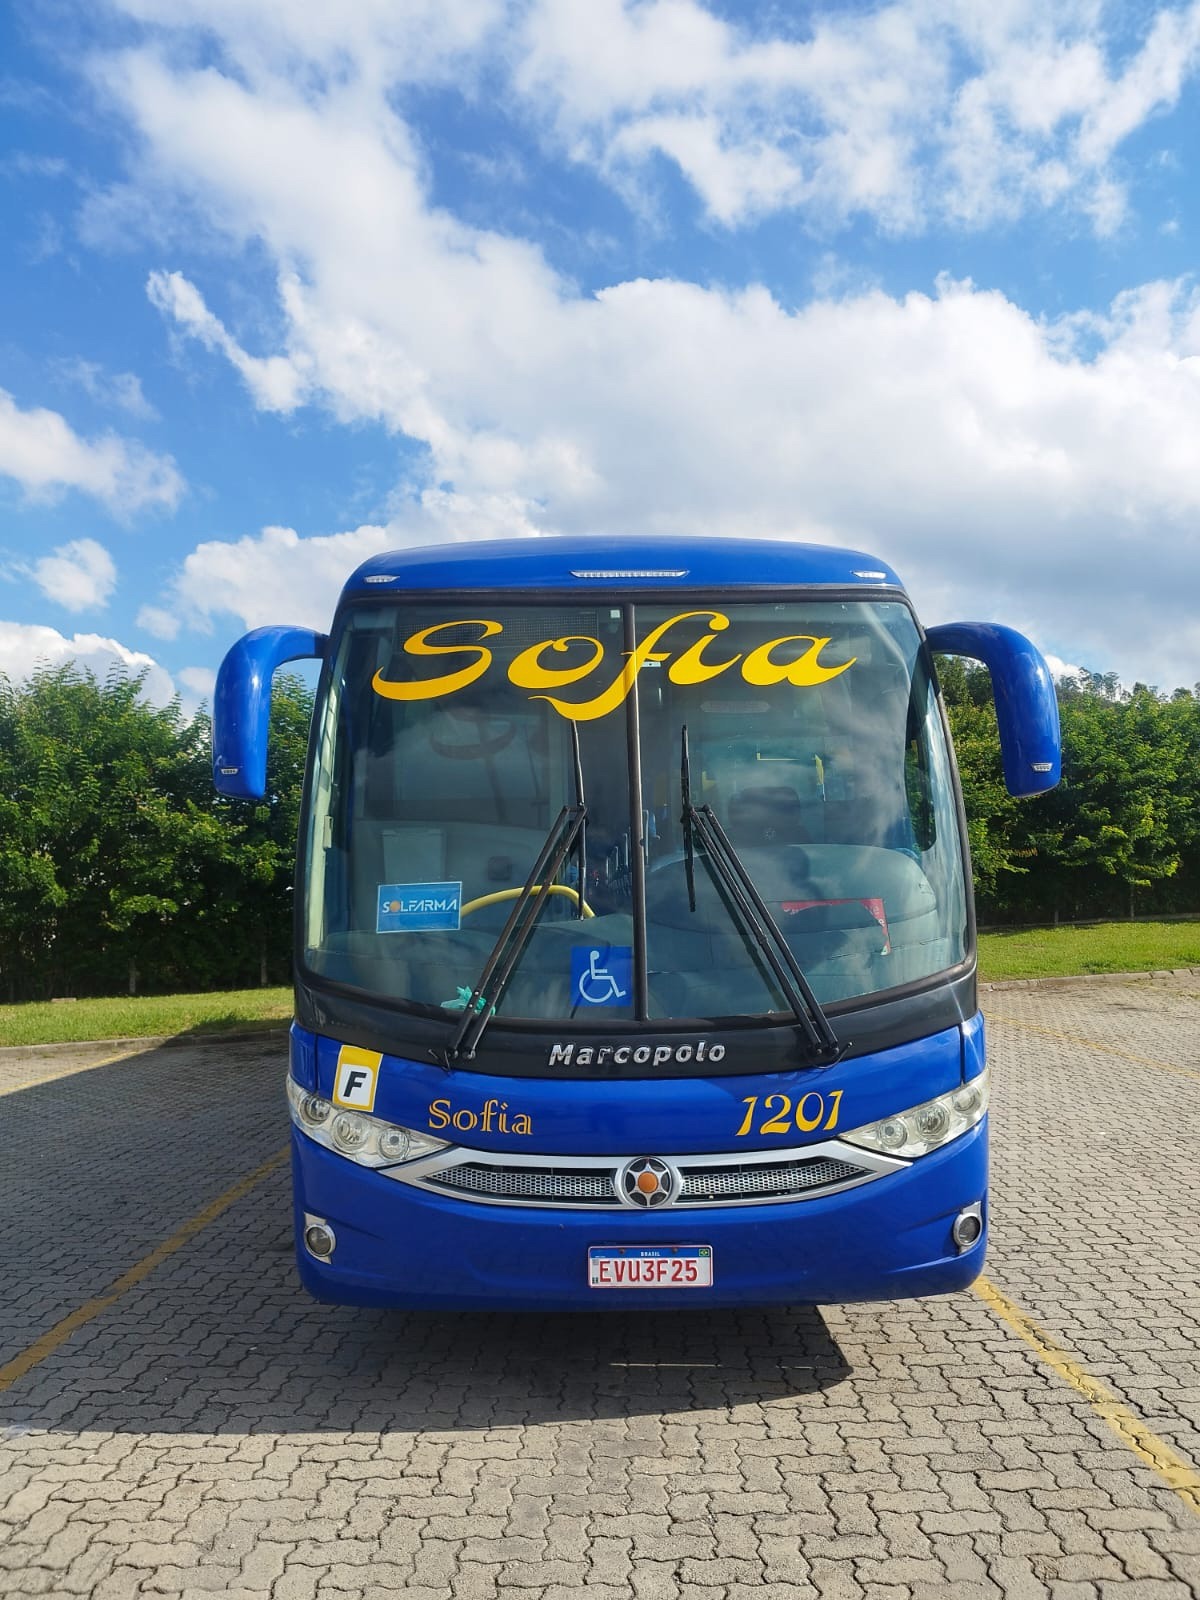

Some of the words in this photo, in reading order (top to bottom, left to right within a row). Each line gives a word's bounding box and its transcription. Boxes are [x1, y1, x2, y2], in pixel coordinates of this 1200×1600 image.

[372, 611, 857, 721] Sofia
[382, 899, 457, 914] SOLFARMA
[548, 1040, 726, 1066] Marcopolo
[343, 1071, 367, 1097] F
[428, 1098, 533, 1136] Sofia
[735, 1089, 844, 1136] 1201
[600, 1260, 698, 1282] EVU3F25
